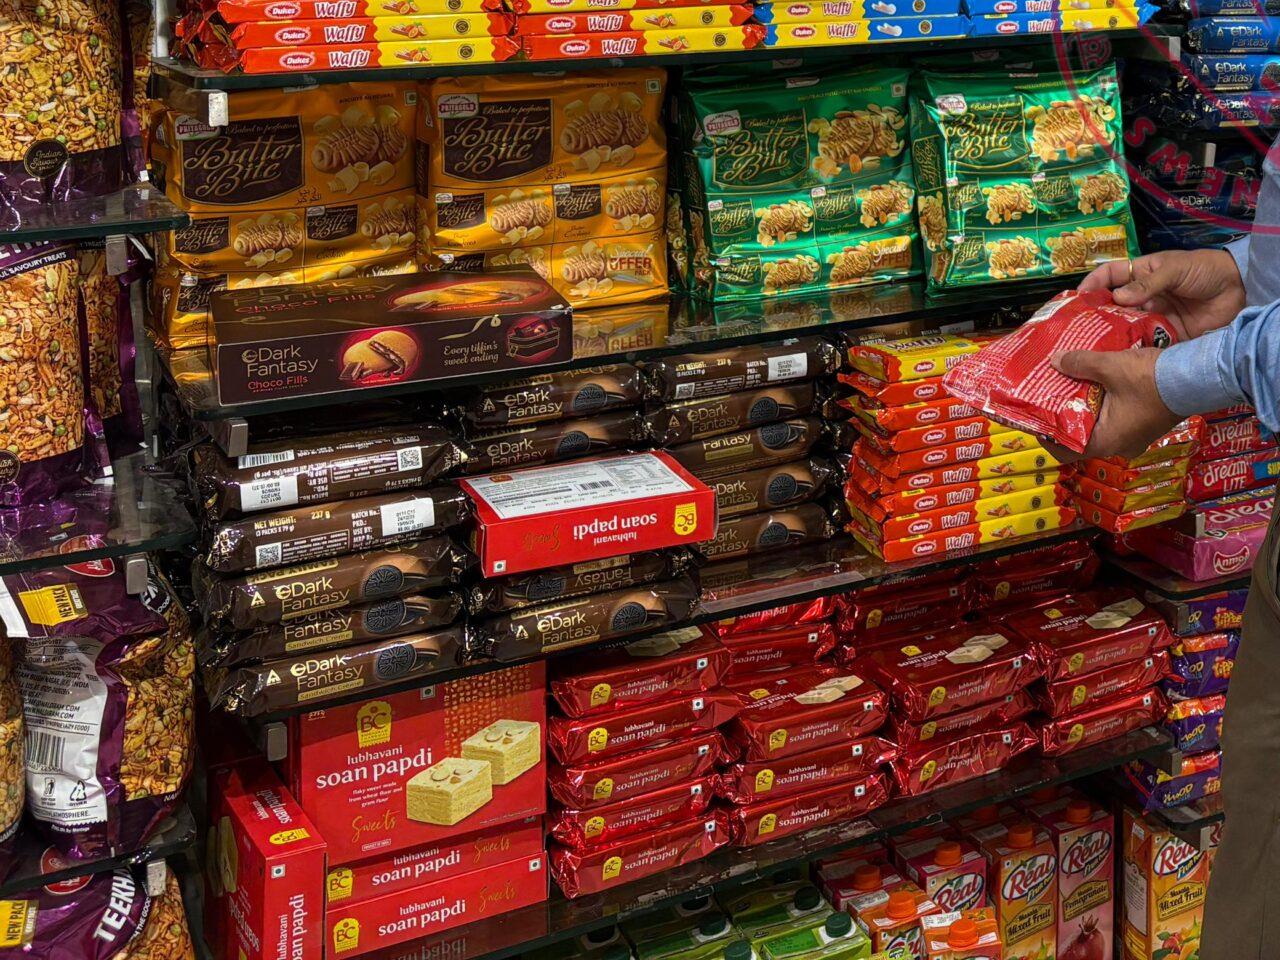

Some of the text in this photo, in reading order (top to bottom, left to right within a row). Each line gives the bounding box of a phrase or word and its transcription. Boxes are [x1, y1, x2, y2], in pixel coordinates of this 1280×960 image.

[827, 22, 859, 39] Waffy
[286, 50, 370, 68] Dukes Waffy
[1224, 62, 1246, 72] Dark
[1217, 72, 1255, 83] Fantasy
[445, 116, 550, 148] Butter
[455, 140, 535, 174] Bite
[9, 251, 66, 274] SAVOURY TREATS
[257, 345, 301, 362] Dark
[444, 345, 472, 357] Every
[247, 351, 499, 378] Fantasy sweet ending
[248, 375, 308, 390] Choco Fills
[1203, 462, 1248, 489] dream
[1223, 474, 1246, 491] LITE
[946, 488, 974, 505] Waffy
[254, 521, 267, 529] NET
[311, 511, 323, 520] 237
[573, 513, 658, 539] soan papdi
[593, 531, 637, 547] lubhavani
[307, 655, 346, 674] Dark
[297, 665, 363, 691] Fantasy
[360, 713, 390, 733] BC
[611, 724, 665, 744] soan papdi
[347, 746, 403, 765] lubhavani
[316, 748, 432, 789] soan papdi
[1008, 857, 1051, 904] Real
[399, 896, 445, 916] lubhavani
[1159, 893, 1184, 912] Mixed
[378, 900, 466, 936] soan papdi
